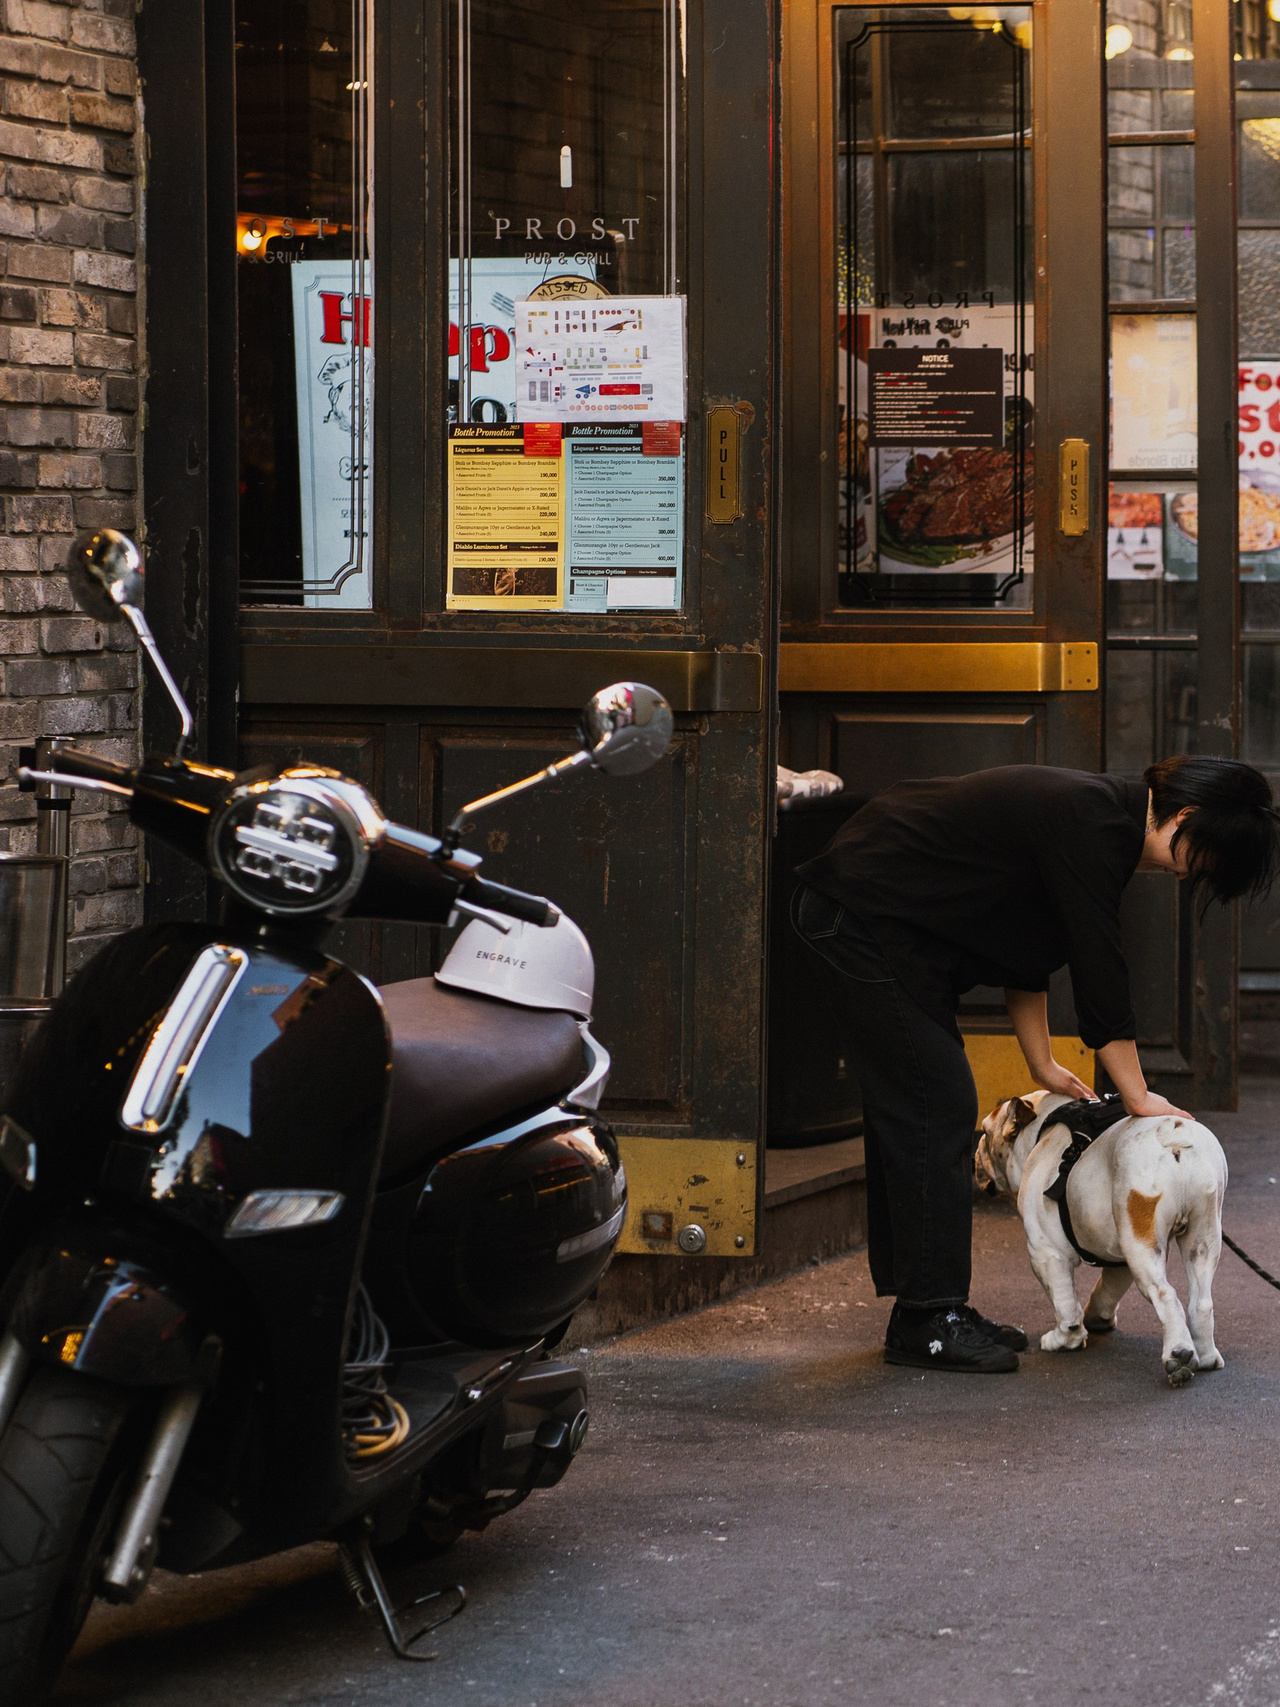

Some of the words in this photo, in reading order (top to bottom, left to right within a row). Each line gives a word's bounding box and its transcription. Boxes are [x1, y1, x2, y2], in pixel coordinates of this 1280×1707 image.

[495, 217, 640, 241] PROST
[263, 251, 303, 264] GRILL
[524, 251, 552, 265] PUB
[558, 252, 568, 265] &
[574, 251, 612, 265] GRILL
[537, 280, 588, 299] MISSED
[922, 354, 949, 364] NOTICE
[454, 428, 474, 437] Bottle
[475, 428, 515, 437] Promotion
[571, 426, 593, 435] Bottle
[594, 426, 633, 435] Promotion
[719, 430, 728, 499] PULL
[476, 950, 528, 970] ENGRAVE
